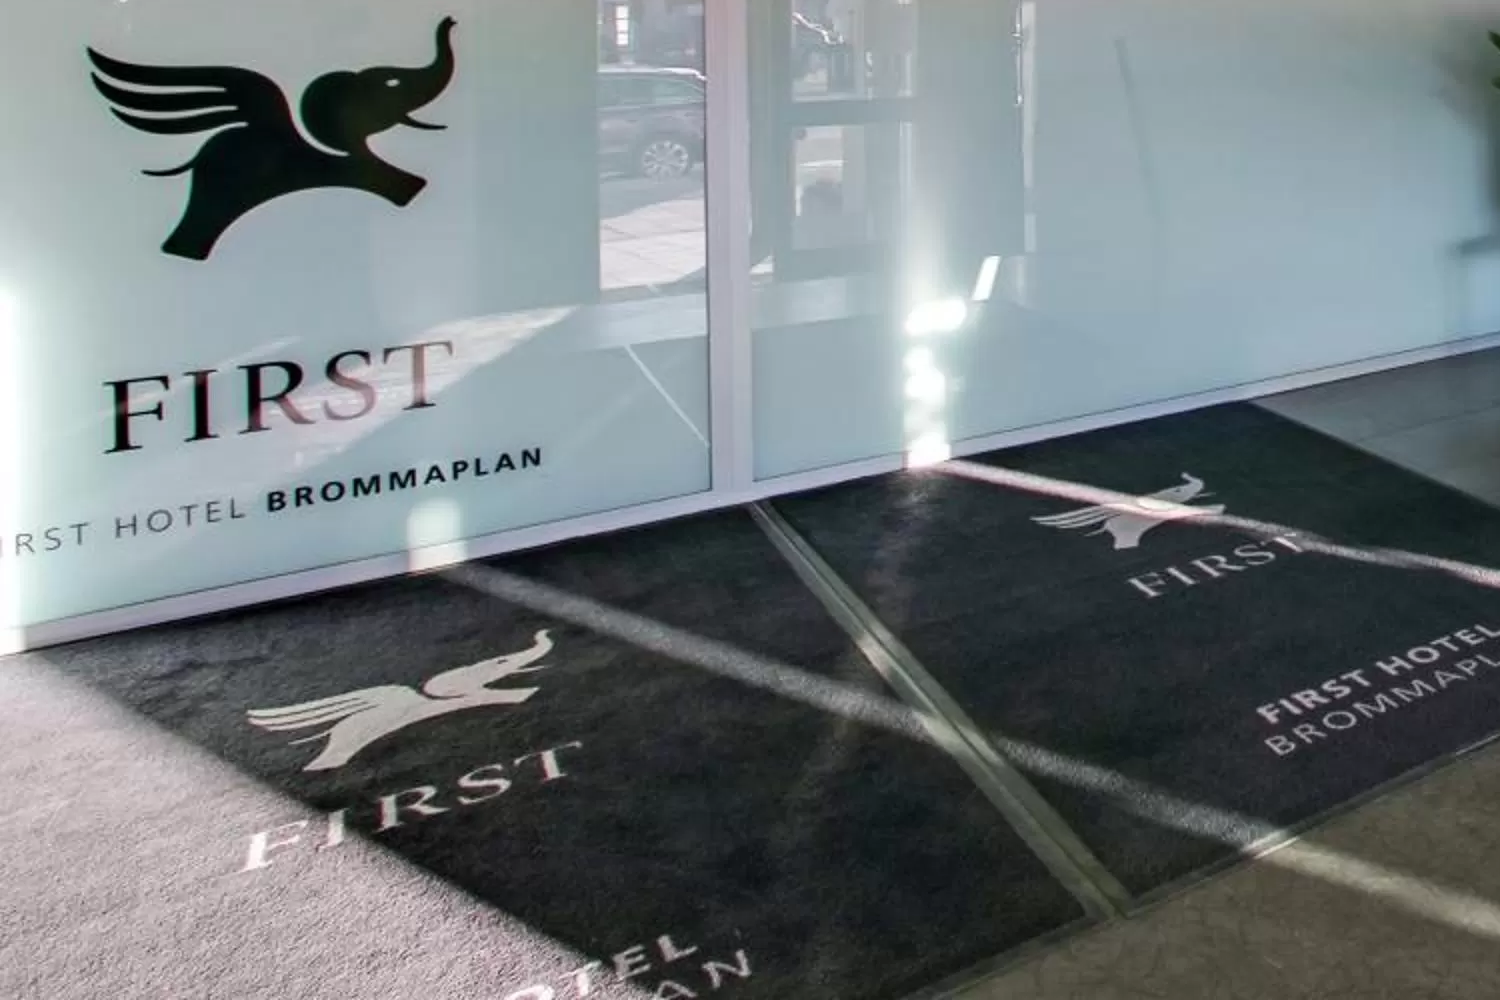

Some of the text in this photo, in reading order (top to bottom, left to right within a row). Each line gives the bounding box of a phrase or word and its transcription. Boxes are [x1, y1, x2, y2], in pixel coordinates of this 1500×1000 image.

[103, 340, 455, 454] FIRST
[115, 498, 246, 540] HOTEL
[266, 447, 543, 513] BROMMAPLAN
[1127, 532, 1306, 599] FIRST
[1256, 668, 1372, 726] FIRST
[232, 740, 583, 875] FIRST
